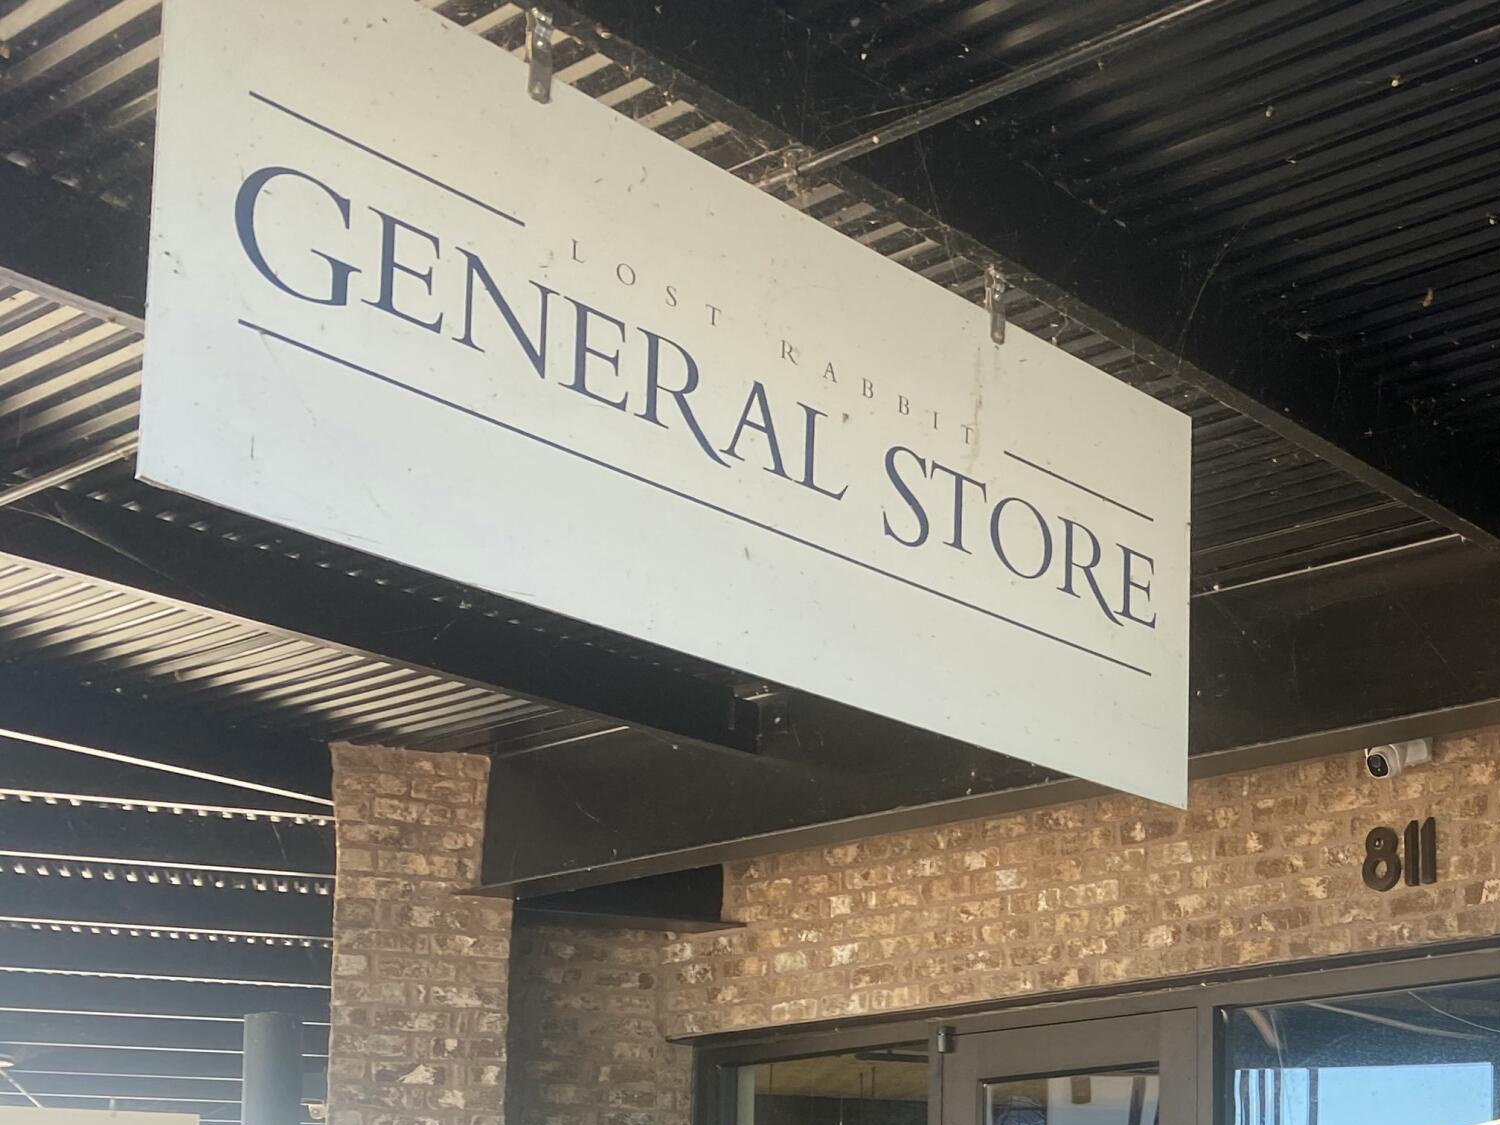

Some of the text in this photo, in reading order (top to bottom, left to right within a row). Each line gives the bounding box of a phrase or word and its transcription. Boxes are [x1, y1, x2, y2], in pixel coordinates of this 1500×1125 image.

[233, 165, 1157, 629] GENERAL STORE
[571, 238, 975, 446] LOST RABBIT
[1361, 816, 1438, 893] 811
